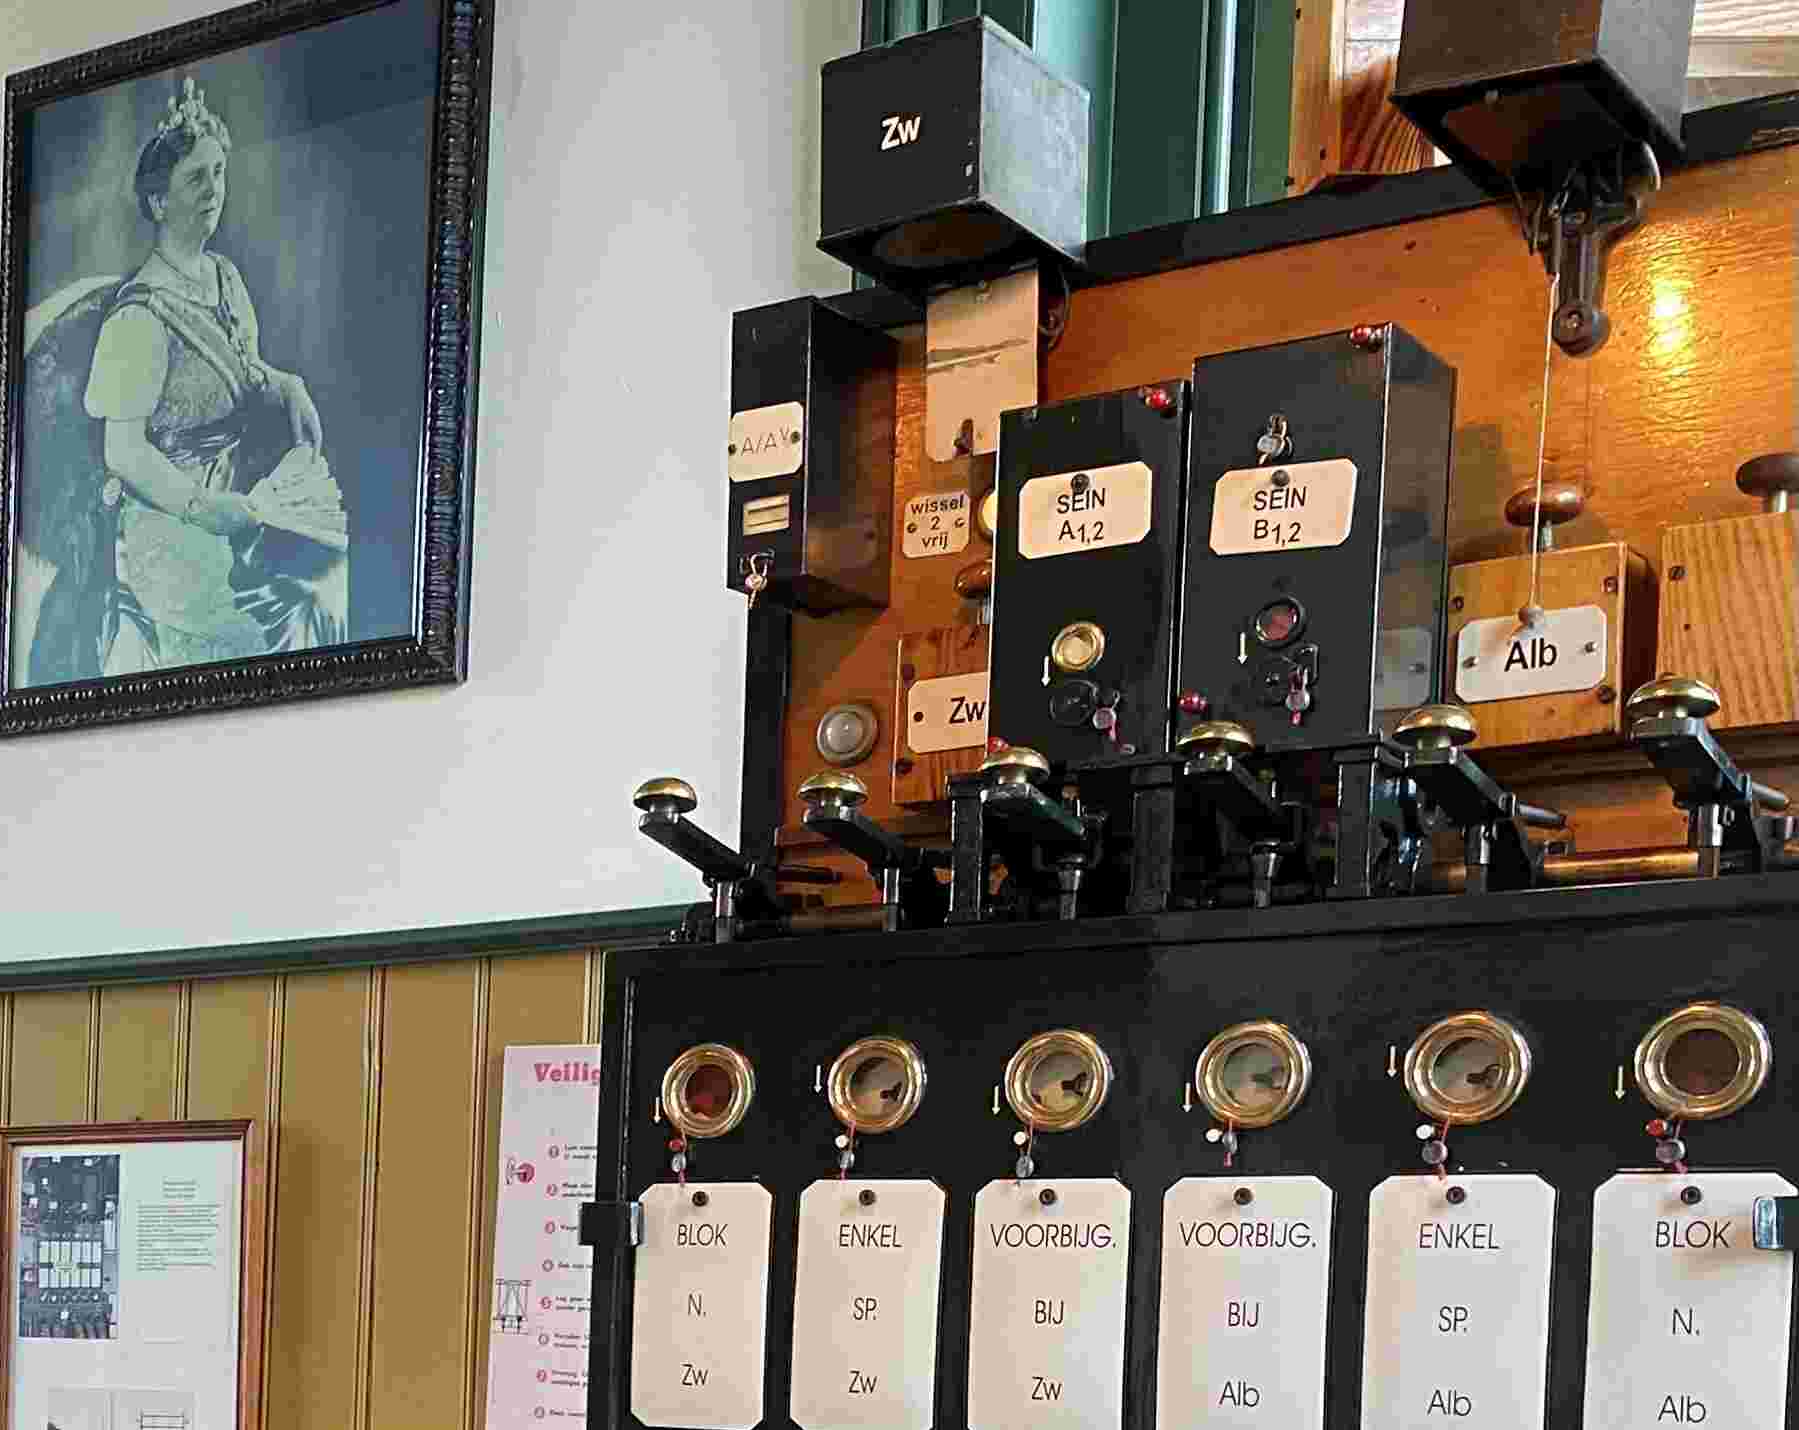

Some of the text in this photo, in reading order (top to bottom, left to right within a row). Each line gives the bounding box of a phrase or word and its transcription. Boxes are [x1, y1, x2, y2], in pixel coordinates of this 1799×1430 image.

[882, 117, 920, 150] Zw
[911, 494, 964, 514] wissel
[1057, 487, 1106, 514] SEIN
[1254, 486, 1306, 511] SEIN
[930, 516, 940, 530] 2
[1059, 520, 1104, 543] A1,2
[1254, 520, 1301, 545] B1,2
[922, 533, 947, 549] vrij
[1504, 638, 1557, 672] Alb
[949, 696, 986, 724] Zw
[678, 1224, 728, 1246] BLOK
[840, 1224, 901, 1247] ENKEL
[991, 1224, 1115, 1248] VOORBIJG.
[1180, 1222, 1315, 1247] VOORBIJG.
[1420, 1224, 1499, 1249] ENKEL
[1656, 1221, 1731, 1248] BLOK
[688, 1294, 706, 1316] N.
[854, 1298, 877, 1320] SP.
[1035, 1300, 1064, 1324] BIJ
[1229, 1302, 1258, 1327] BIJ
[1439, 1306, 1467, 1332] SP.
[1673, 1308, 1699, 1335] N.
[682, 1364, 708, 1386] Zw
[849, 1371, 877, 1393] Zw
[1032, 1377, 1061, 1400] Zw
[1219, 1381, 1259, 1407] Alb
[1428, 1390, 1471, 1416] Alb
[1658, 1396, 1706, 1423] Alb
